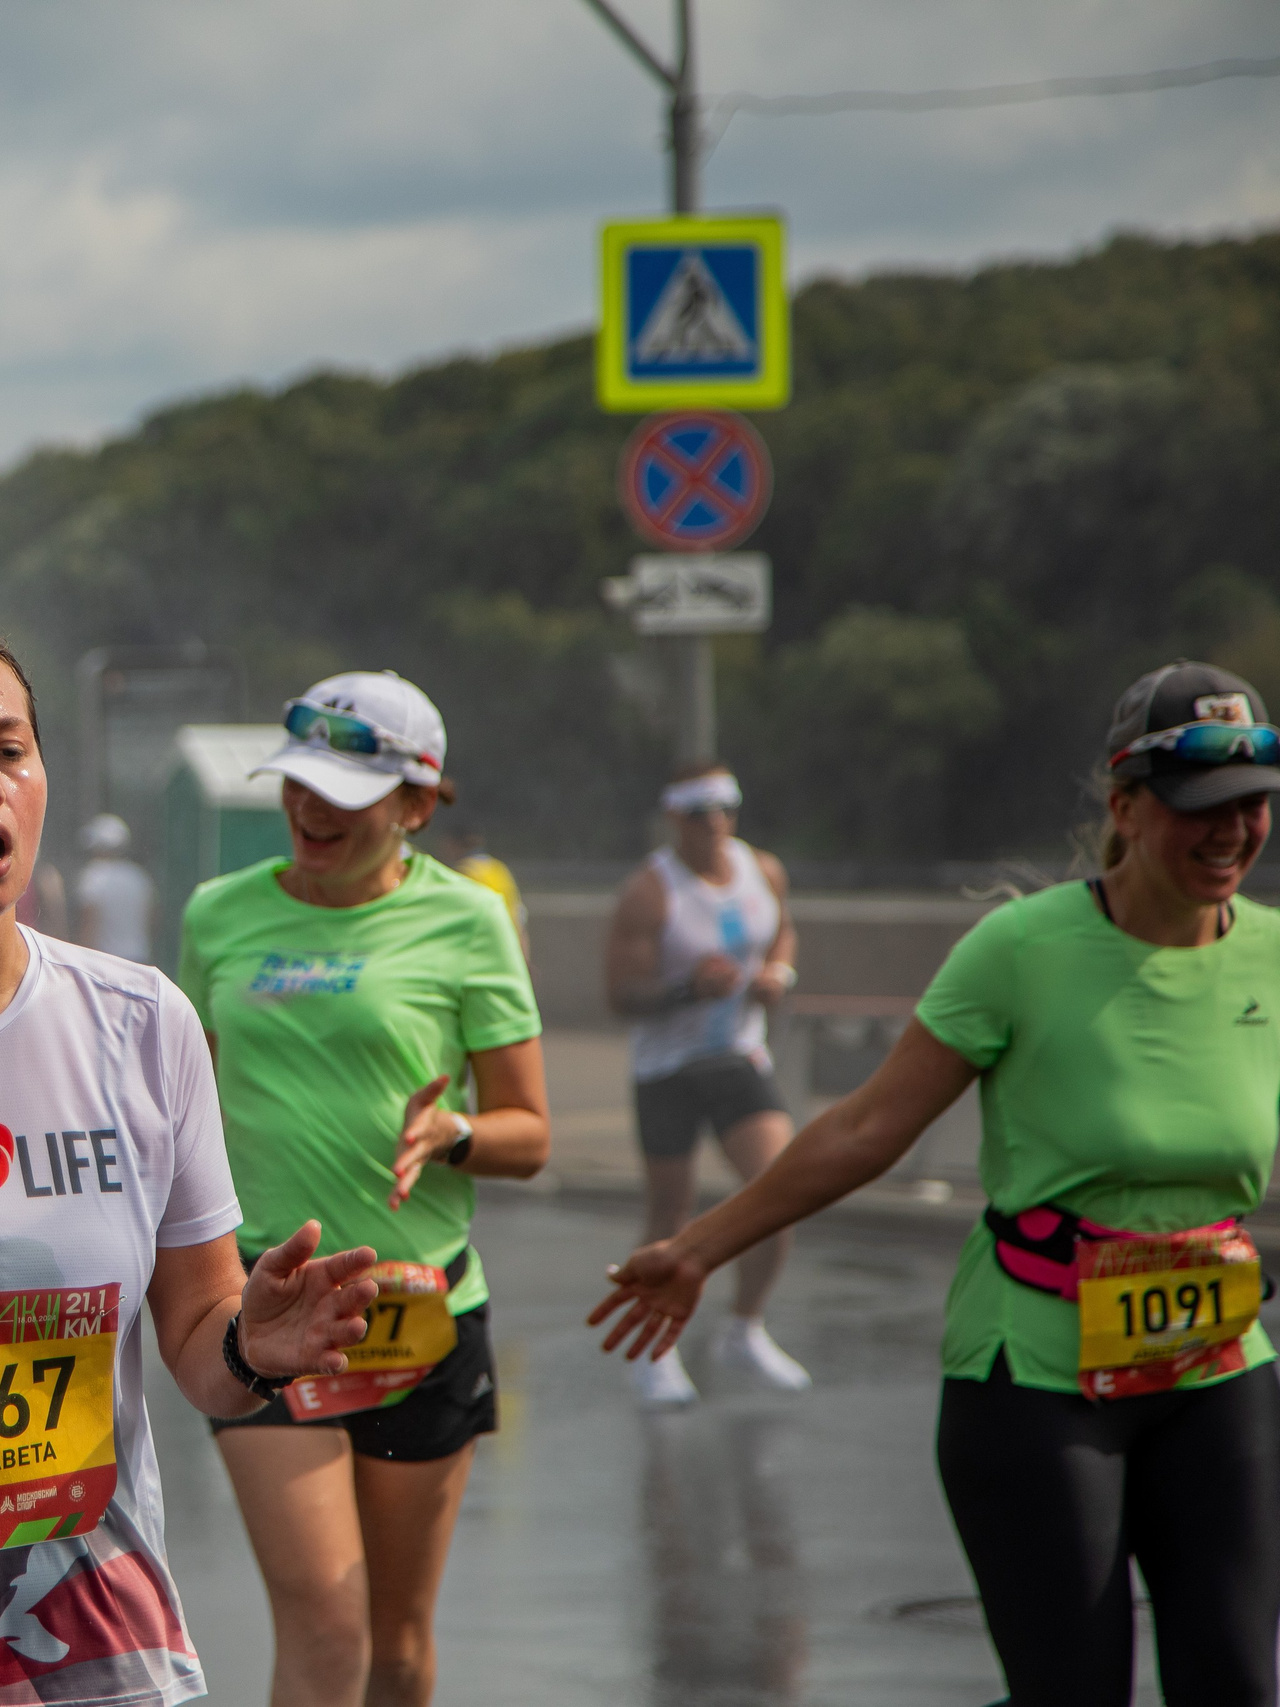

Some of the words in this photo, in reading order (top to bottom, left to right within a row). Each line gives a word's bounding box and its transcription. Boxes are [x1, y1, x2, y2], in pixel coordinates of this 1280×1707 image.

[15, 1129, 123, 1198] LIFE
[66, 1289, 106, 1315] 21,1
[1118, 1278, 1223, 1338] 1091
[297, 1381, 322, 1410] E
[17, 1486, 58, 1502] МОСКОВСКИЙ
[17, 1500, 36, 1511] СПОРТ
